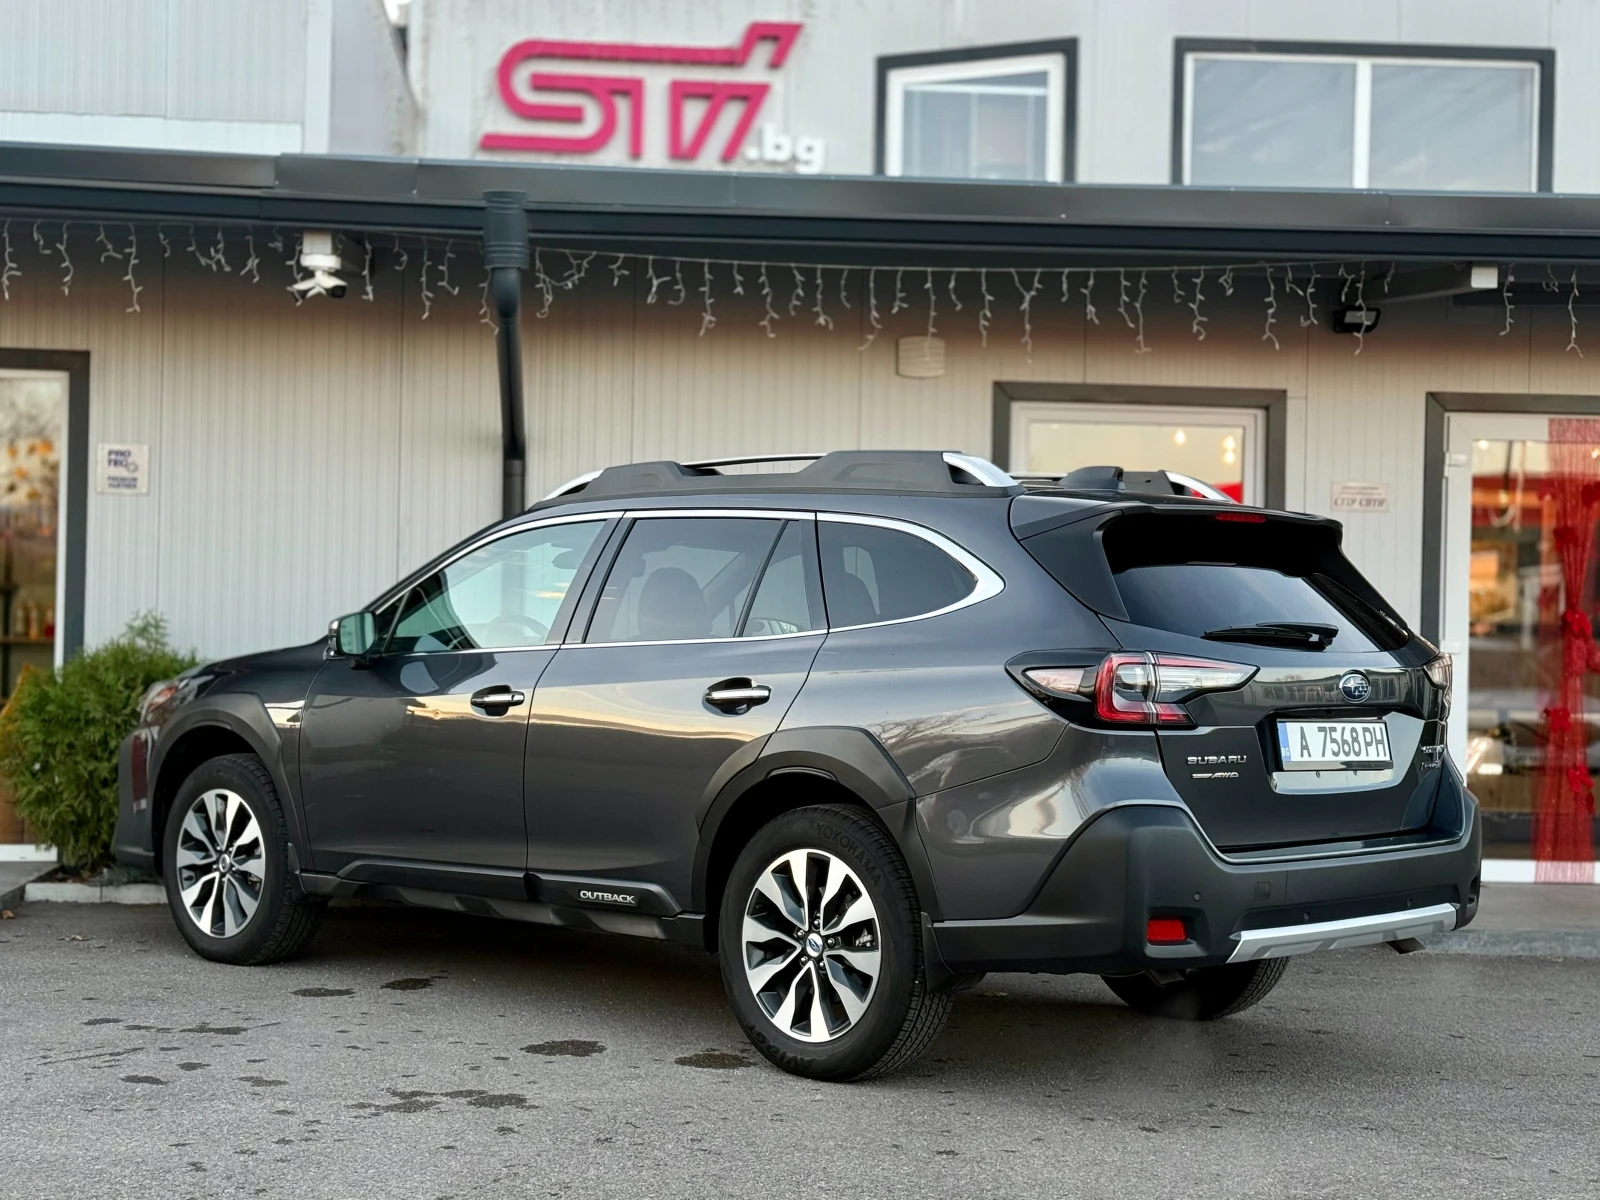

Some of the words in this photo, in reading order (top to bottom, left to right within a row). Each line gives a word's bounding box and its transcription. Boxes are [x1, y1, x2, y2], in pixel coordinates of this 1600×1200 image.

[1300, 726, 1312, 758] A
[1317, 726, 1362, 758] 7568
[1187, 755, 1247, 765] SUBARU
[1211, 771, 1240, 779] AWD
[816, 822, 882, 888] YOKOHAMA
[579, 890, 636, 904] OUTBACK
